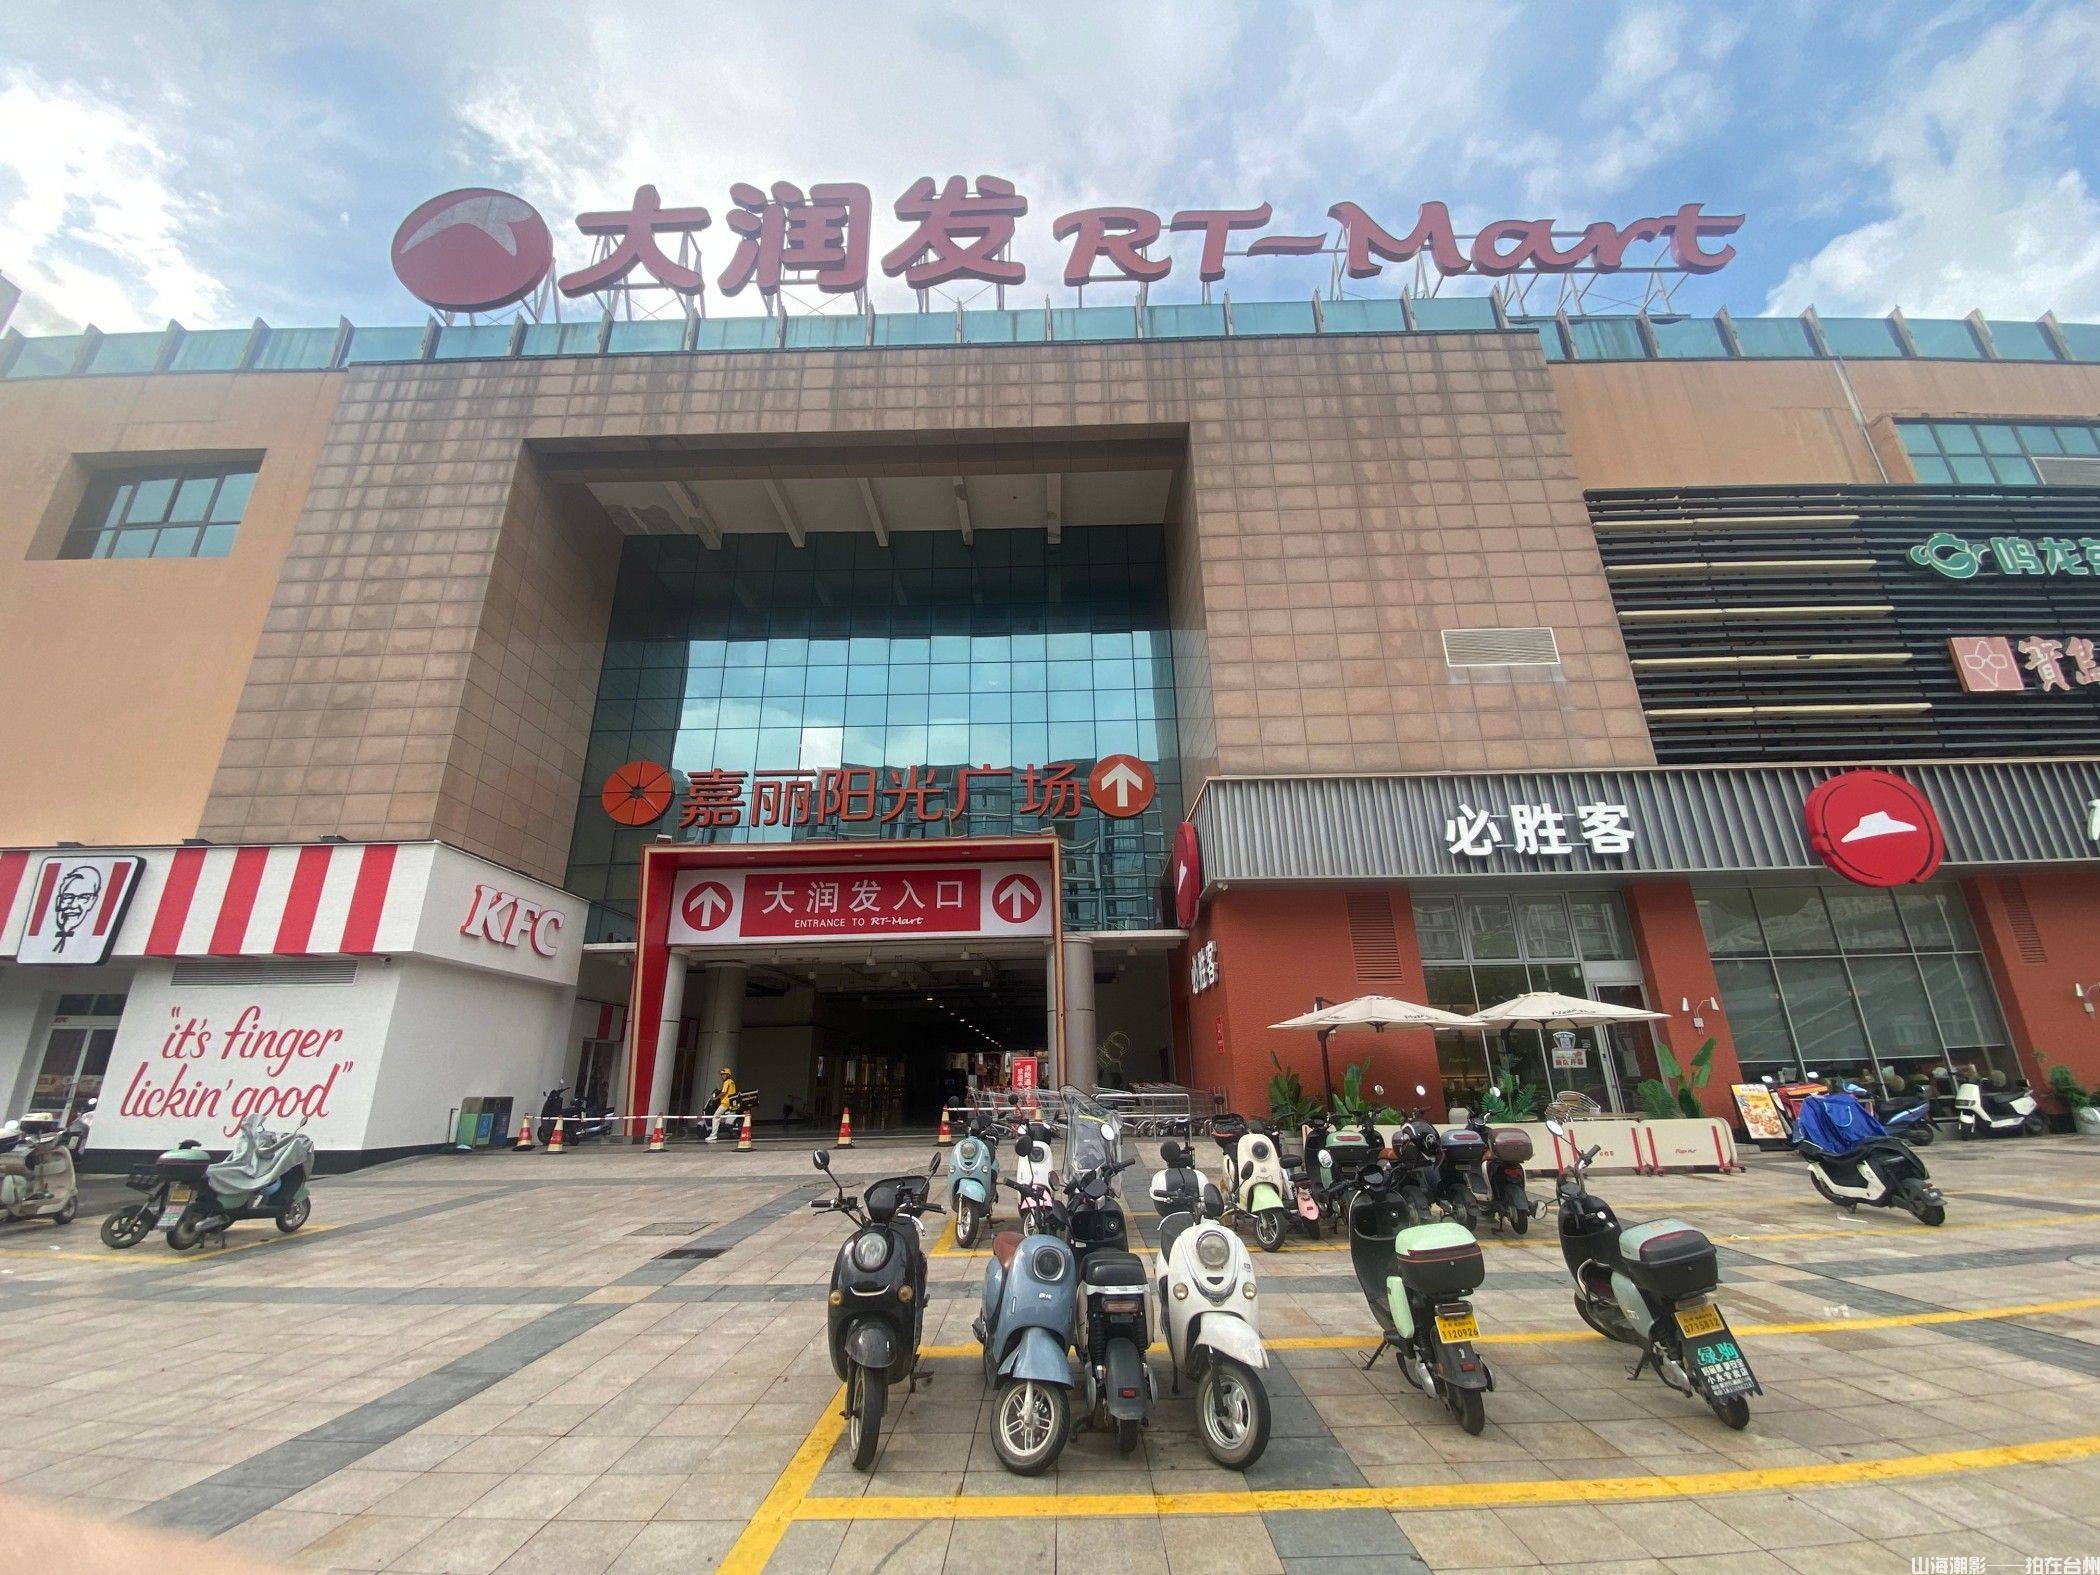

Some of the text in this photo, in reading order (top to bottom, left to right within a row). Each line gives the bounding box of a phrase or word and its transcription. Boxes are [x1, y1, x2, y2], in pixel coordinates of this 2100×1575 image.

[557, 175, 1746, 297] 大润发 RT-Mart
[679, 763, 1081, 828] 嘉丽阳光广场
[1446, 802, 1635, 856] 必胜客
[460, 884, 566, 958] KFC
[762, 879, 963, 914] 大润发入口
[794, 916, 923, 928] ENTRANCE TO RT-Mart
[221, 1005, 343, 1078] finger
